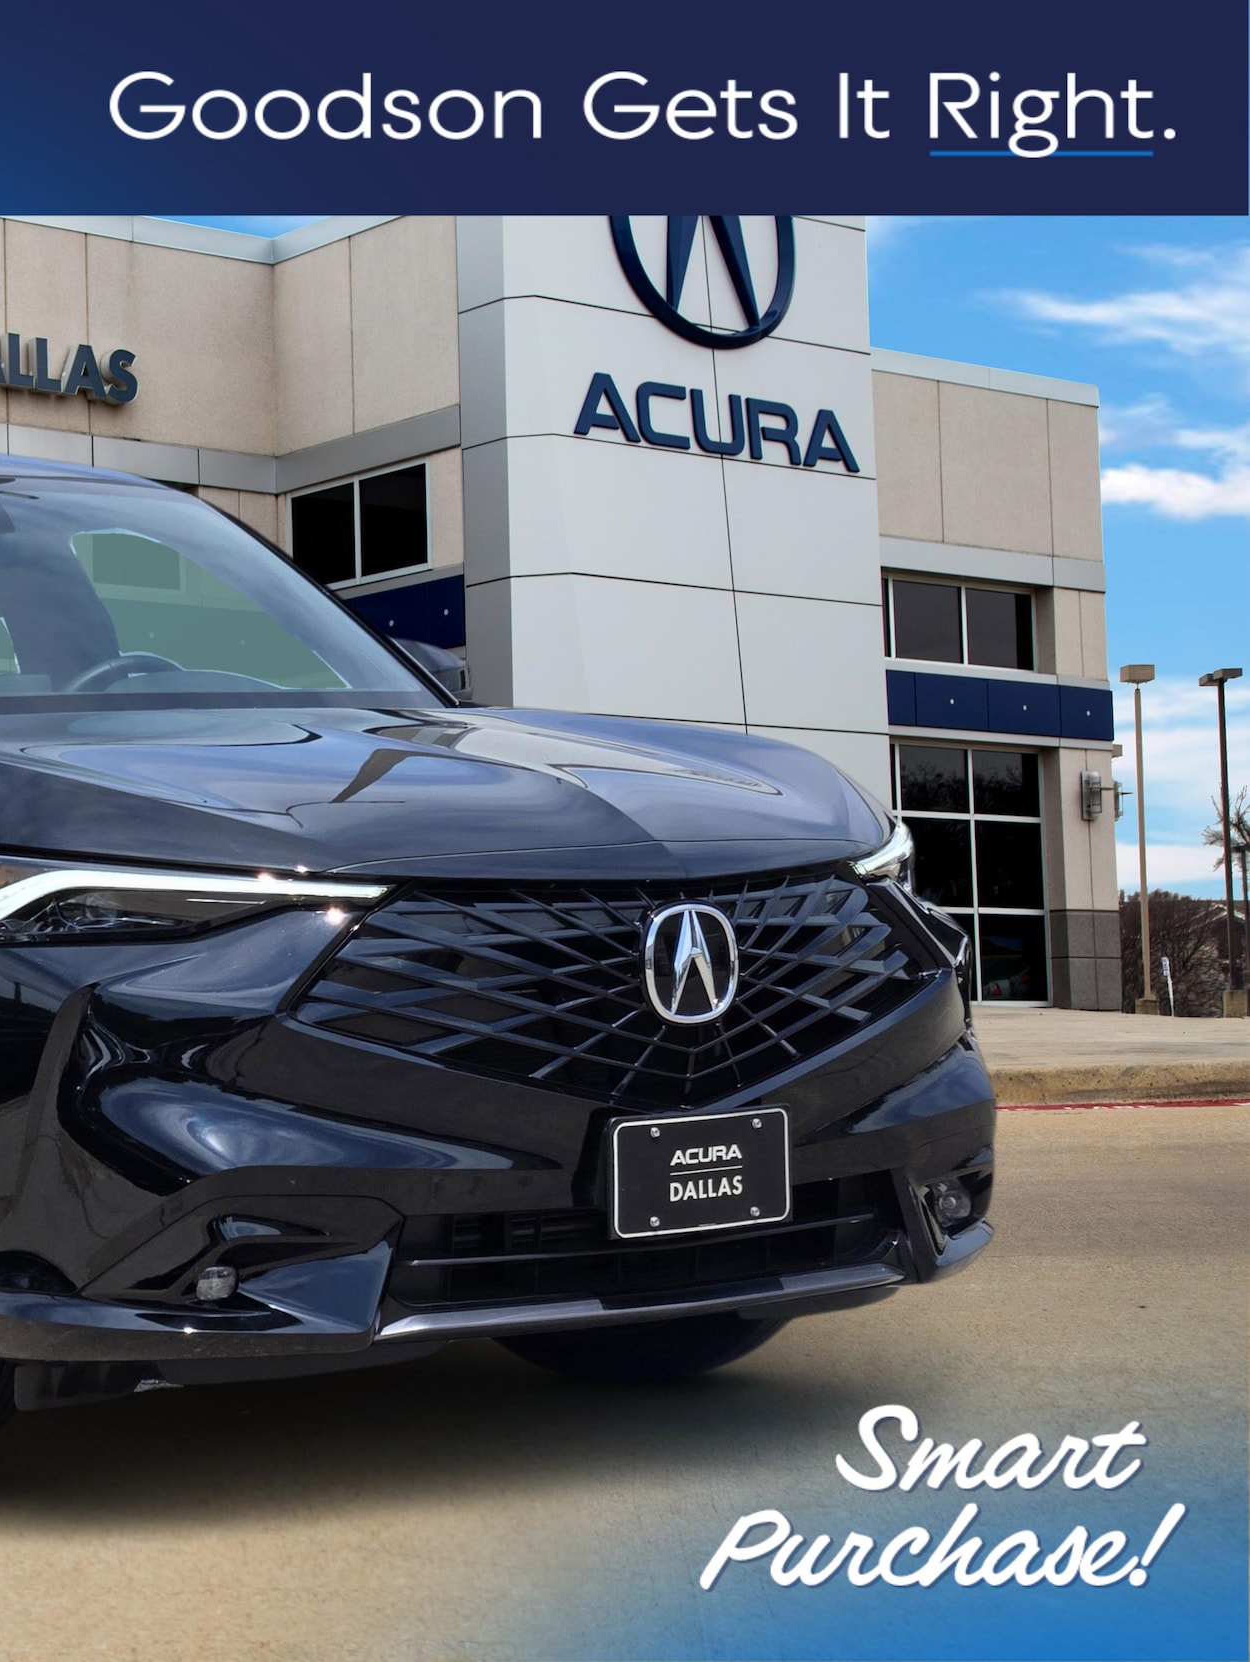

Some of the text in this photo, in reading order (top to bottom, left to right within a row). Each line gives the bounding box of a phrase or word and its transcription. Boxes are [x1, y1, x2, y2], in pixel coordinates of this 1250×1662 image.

[573, 372, 860, 473] ACURA
[669, 1144, 743, 1166] ACURA
[669, 1175, 743, 1202] DALLAS
